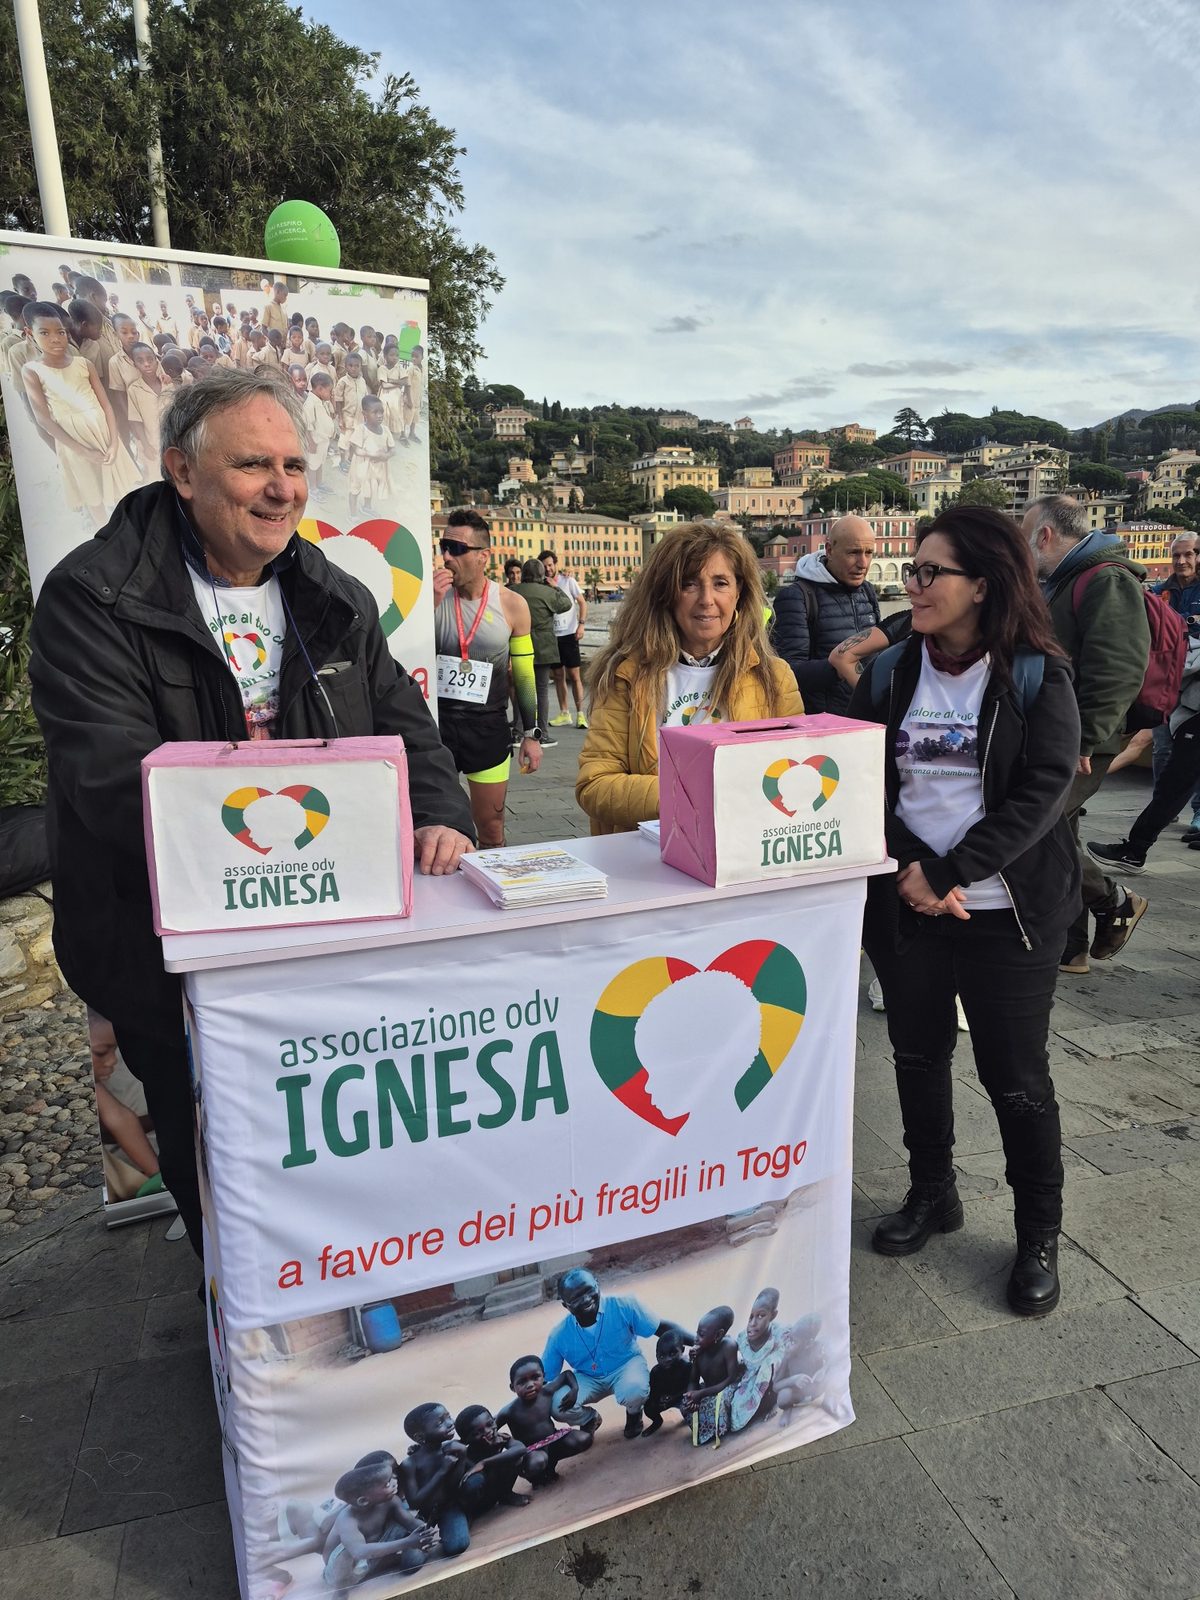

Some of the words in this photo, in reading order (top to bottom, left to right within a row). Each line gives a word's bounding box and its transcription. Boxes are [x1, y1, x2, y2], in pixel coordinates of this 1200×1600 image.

[209, 613, 237, 632] alore
[241, 612, 253, 624] al
[255, 615, 271, 636] tuo
[448, 669, 476, 688] 239
[670, 691, 700, 710] valore
[943, 710, 955, 719] al
[940, 769, 973, 777] bambini
[762, 821, 821, 838] associazione
[823, 818, 841, 829] odv
[760, 829, 842, 866] IGNESA
[224, 860, 308, 877] associazione
[311, 858, 335, 871] odv
[222, 872, 340, 911] IGNESA
[279, 1007, 496, 1068] associazione
[505, 988, 560, 1030] odv
[275, 1030, 570, 1169] IGNESA
[277, 1258, 304, 1290] a
[317, 1226, 445, 1281] favore
[457, 1203, 516, 1247] dei
[528, 1188, 584, 1241] più
[596, 1165, 688, 1214] fragili
[698, 1160, 726, 1192] in
[737, 1140, 808, 1180] Togo
